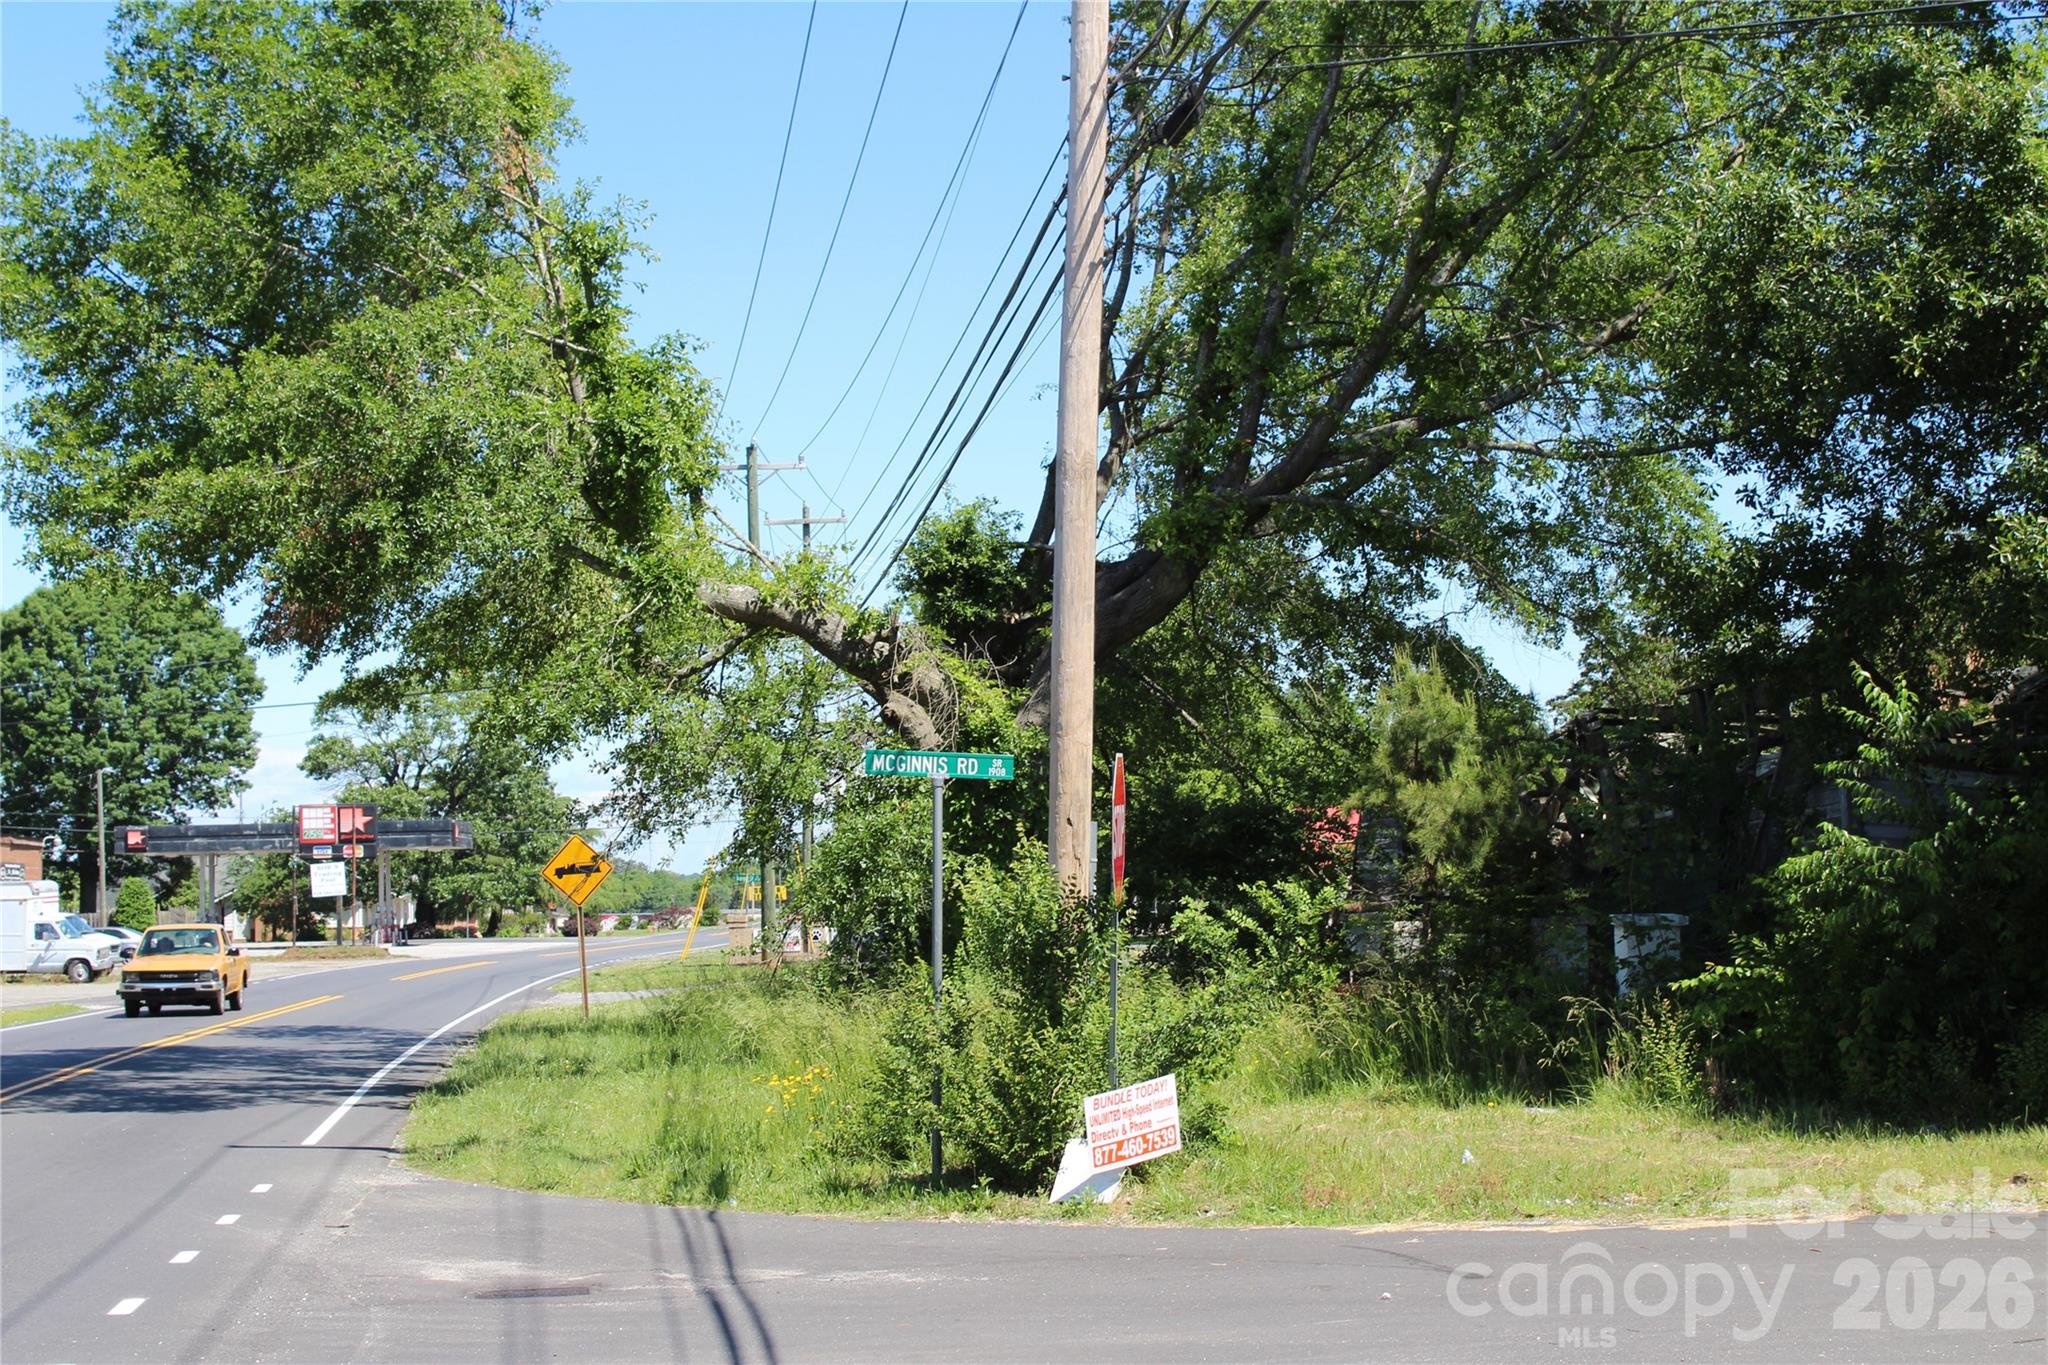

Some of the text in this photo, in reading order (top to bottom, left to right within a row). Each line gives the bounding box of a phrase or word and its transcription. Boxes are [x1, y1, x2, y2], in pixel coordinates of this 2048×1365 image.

[872, 754, 978, 775] MCGINNIS RD
[991, 759, 1003, 767] SR
[1093, 1079, 1168, 1111] BUNDLE TODAY!
[1089, 1096, 1174, 1127] UNLIMITED High-Speed Internet
[1121, 1124, 1127, 1136] &
[1129, 1119, 1152, 1134] Phone
[1094, 1126, 1176, 1166] 877-460-7539
